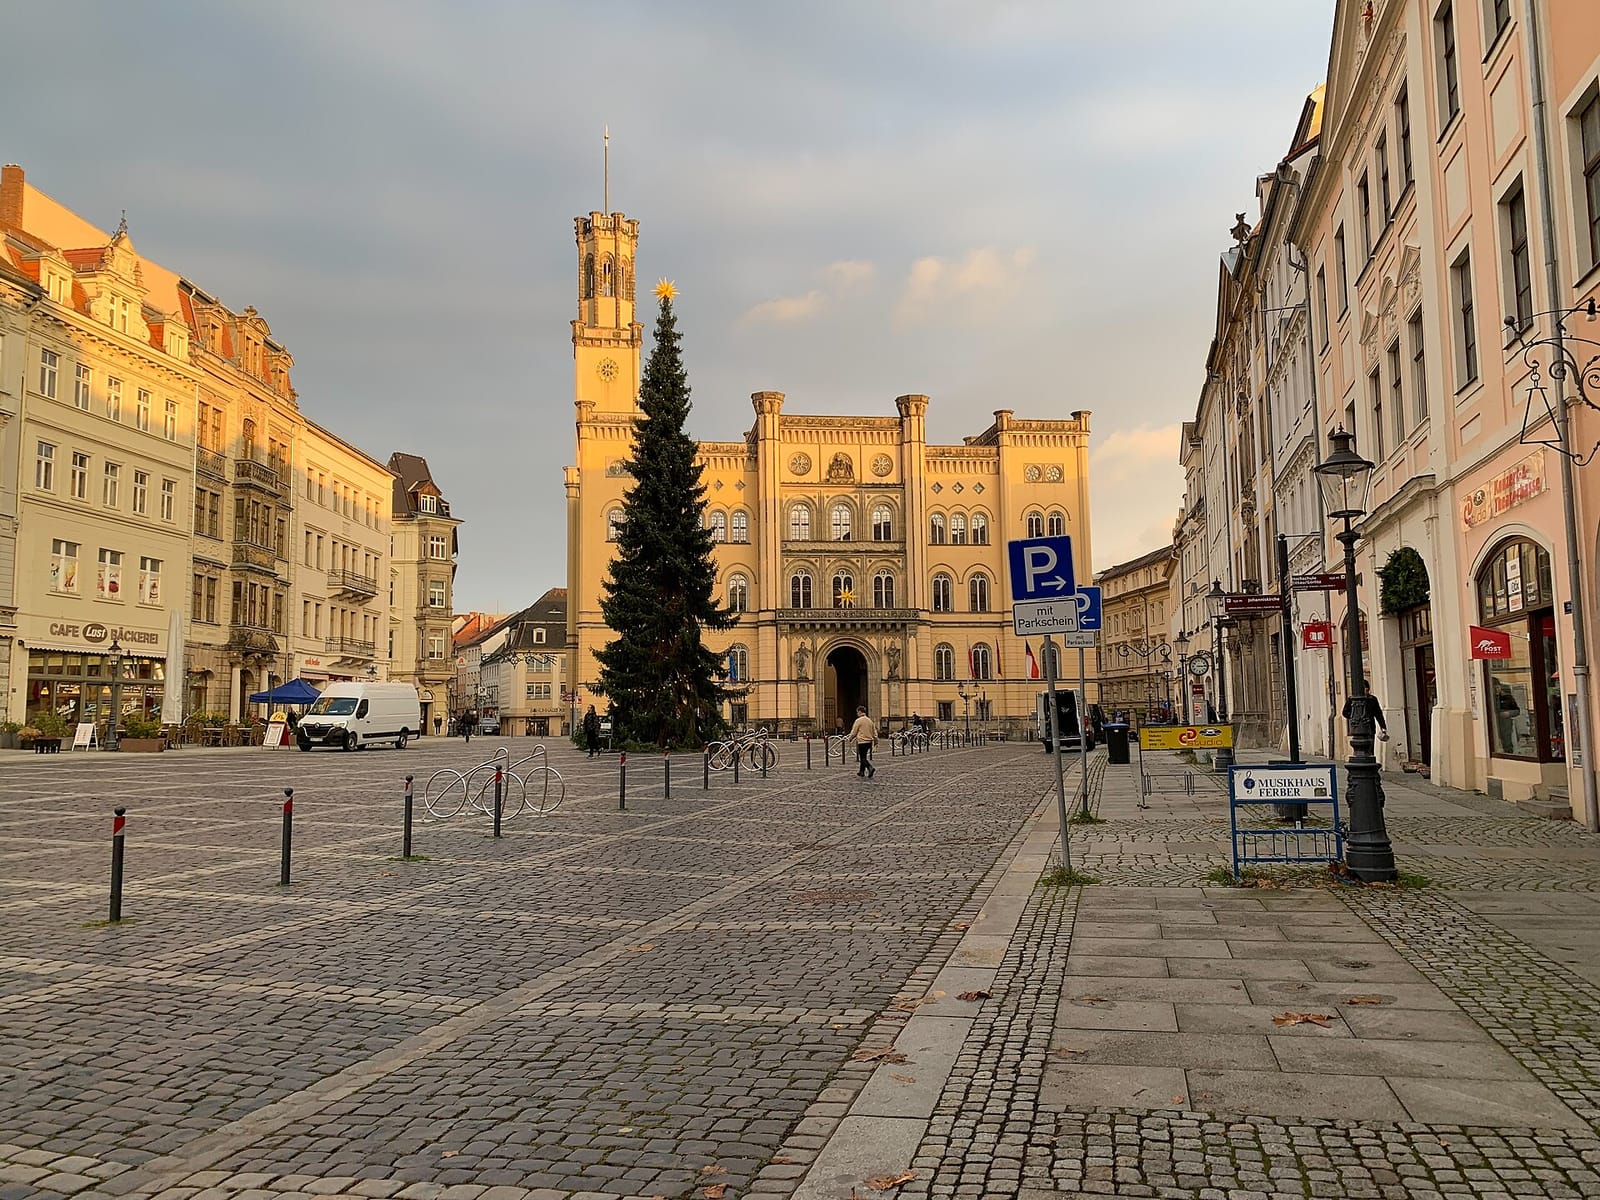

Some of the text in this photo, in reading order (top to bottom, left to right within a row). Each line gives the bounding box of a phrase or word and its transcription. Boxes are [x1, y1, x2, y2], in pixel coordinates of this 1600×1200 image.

[1023, 545, 1057, 592] P
[1036, 606, 1054, 616] mit
[1018, 615, 1074, 628] Parkschein
[49, 623, 80, 638] CAFE
[110, 627, 159, 644] BÄCKEREI
[1258, 777, 1325, 788] MUSIKHAUS
[1259, 788, 1301, 797] FERBER
